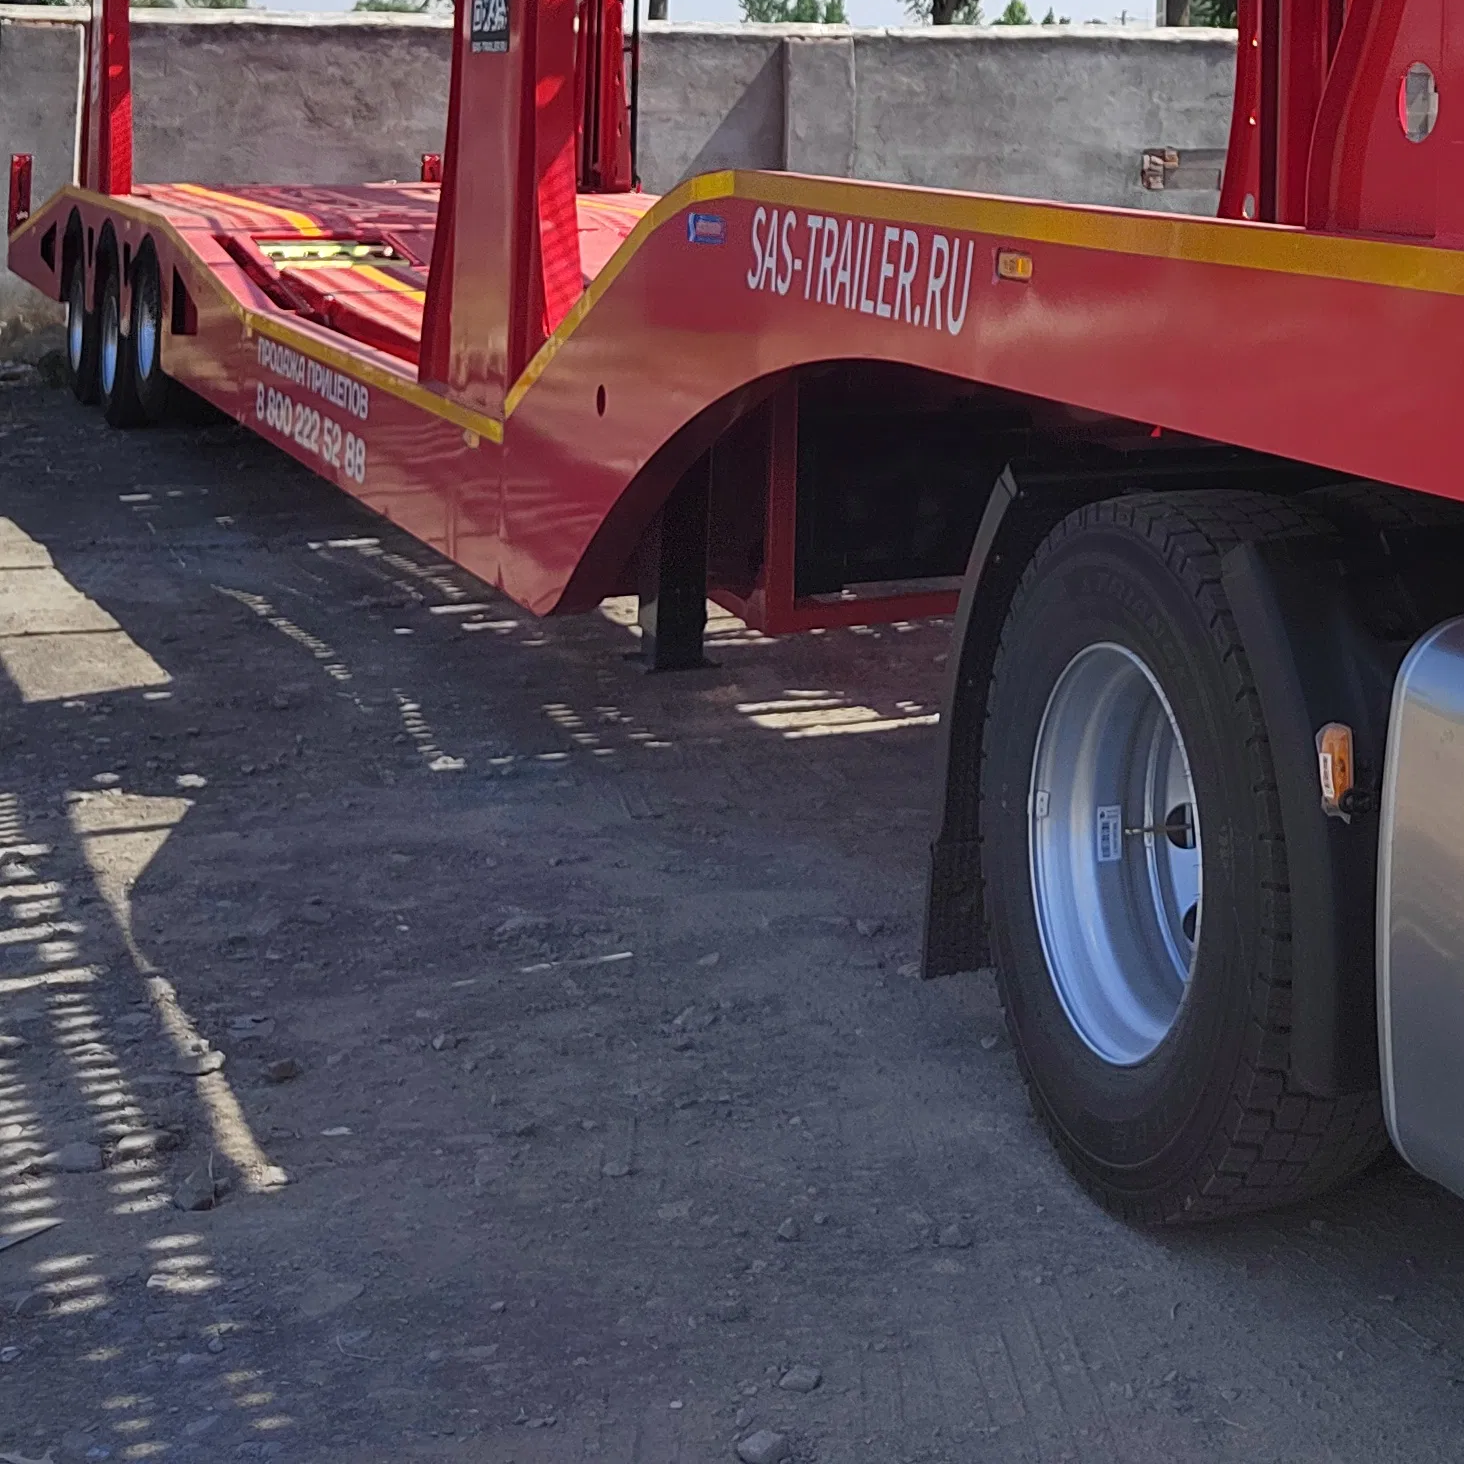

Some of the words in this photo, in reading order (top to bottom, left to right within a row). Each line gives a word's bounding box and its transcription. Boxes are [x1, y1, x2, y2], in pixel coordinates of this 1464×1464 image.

[746, 206, 975, 336] SAS-TRAILER.RU
[257, 336, 306, 388] ПРОДАЖА
[306, 359, 369, 421] ПРИЦЕПОВ
[256, 382, 265, 421] 8
[266, 387, 292, 436] 800
[294, 403, 320, 454] 222
[323, 418, 342, 469] 52
[344, 431, 367, 484] 88
